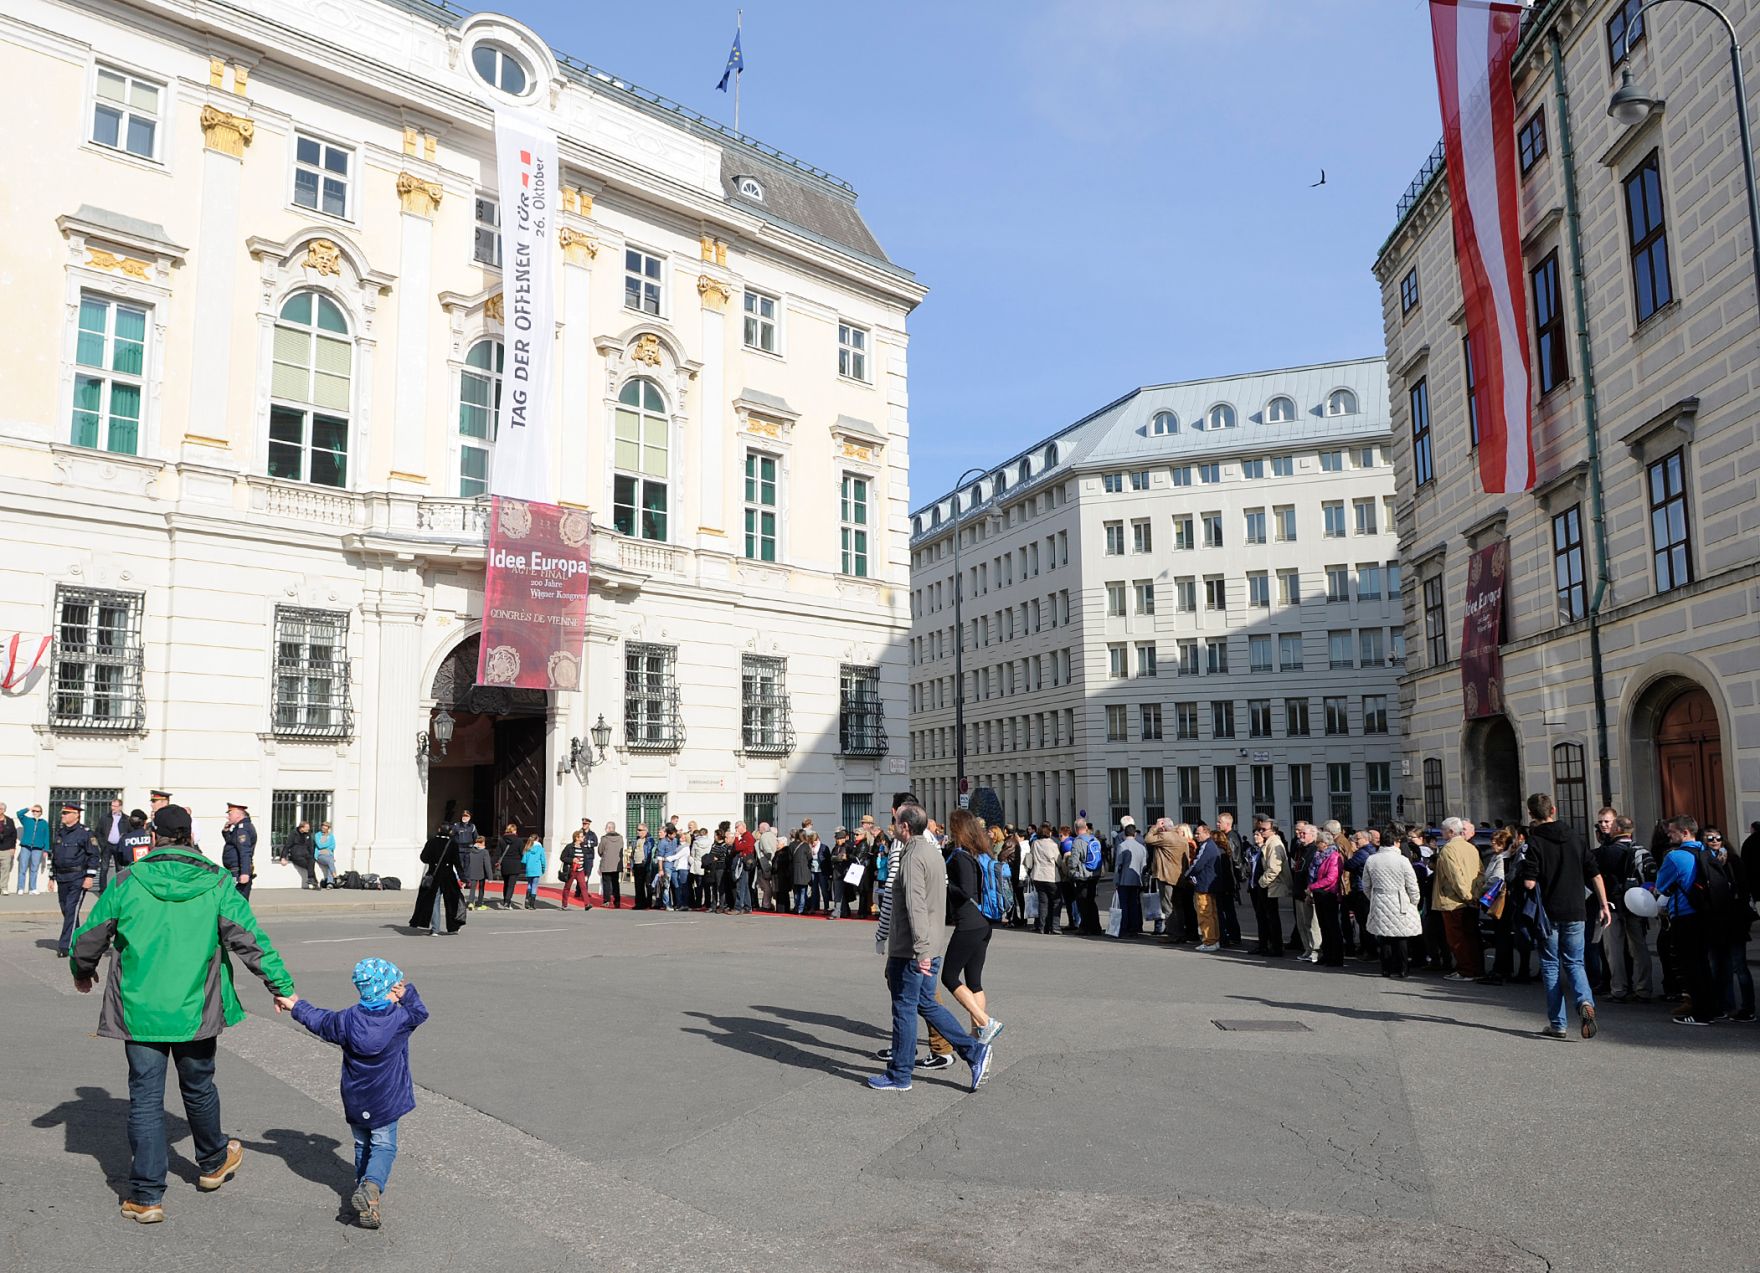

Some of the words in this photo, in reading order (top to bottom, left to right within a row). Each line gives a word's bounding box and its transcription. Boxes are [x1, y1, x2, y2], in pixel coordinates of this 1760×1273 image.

[532, 157, 545, 210] Oktober
[517, 192, 529, 231] TÜR
[533, 216, 545, 238] 26.
[515, 242, 532, 331] OFFENEN
[515, 338, 530, 381] DER
[511, 389, 527, 429] TAG
[490, 547, 526, 569] Idee
[531, 551, 588, 578] Europa
[544, 578, 563, 588] Jahre
[490, 608, 532, 622] CONGRÈS
[533, 613, 545, 623] DE
